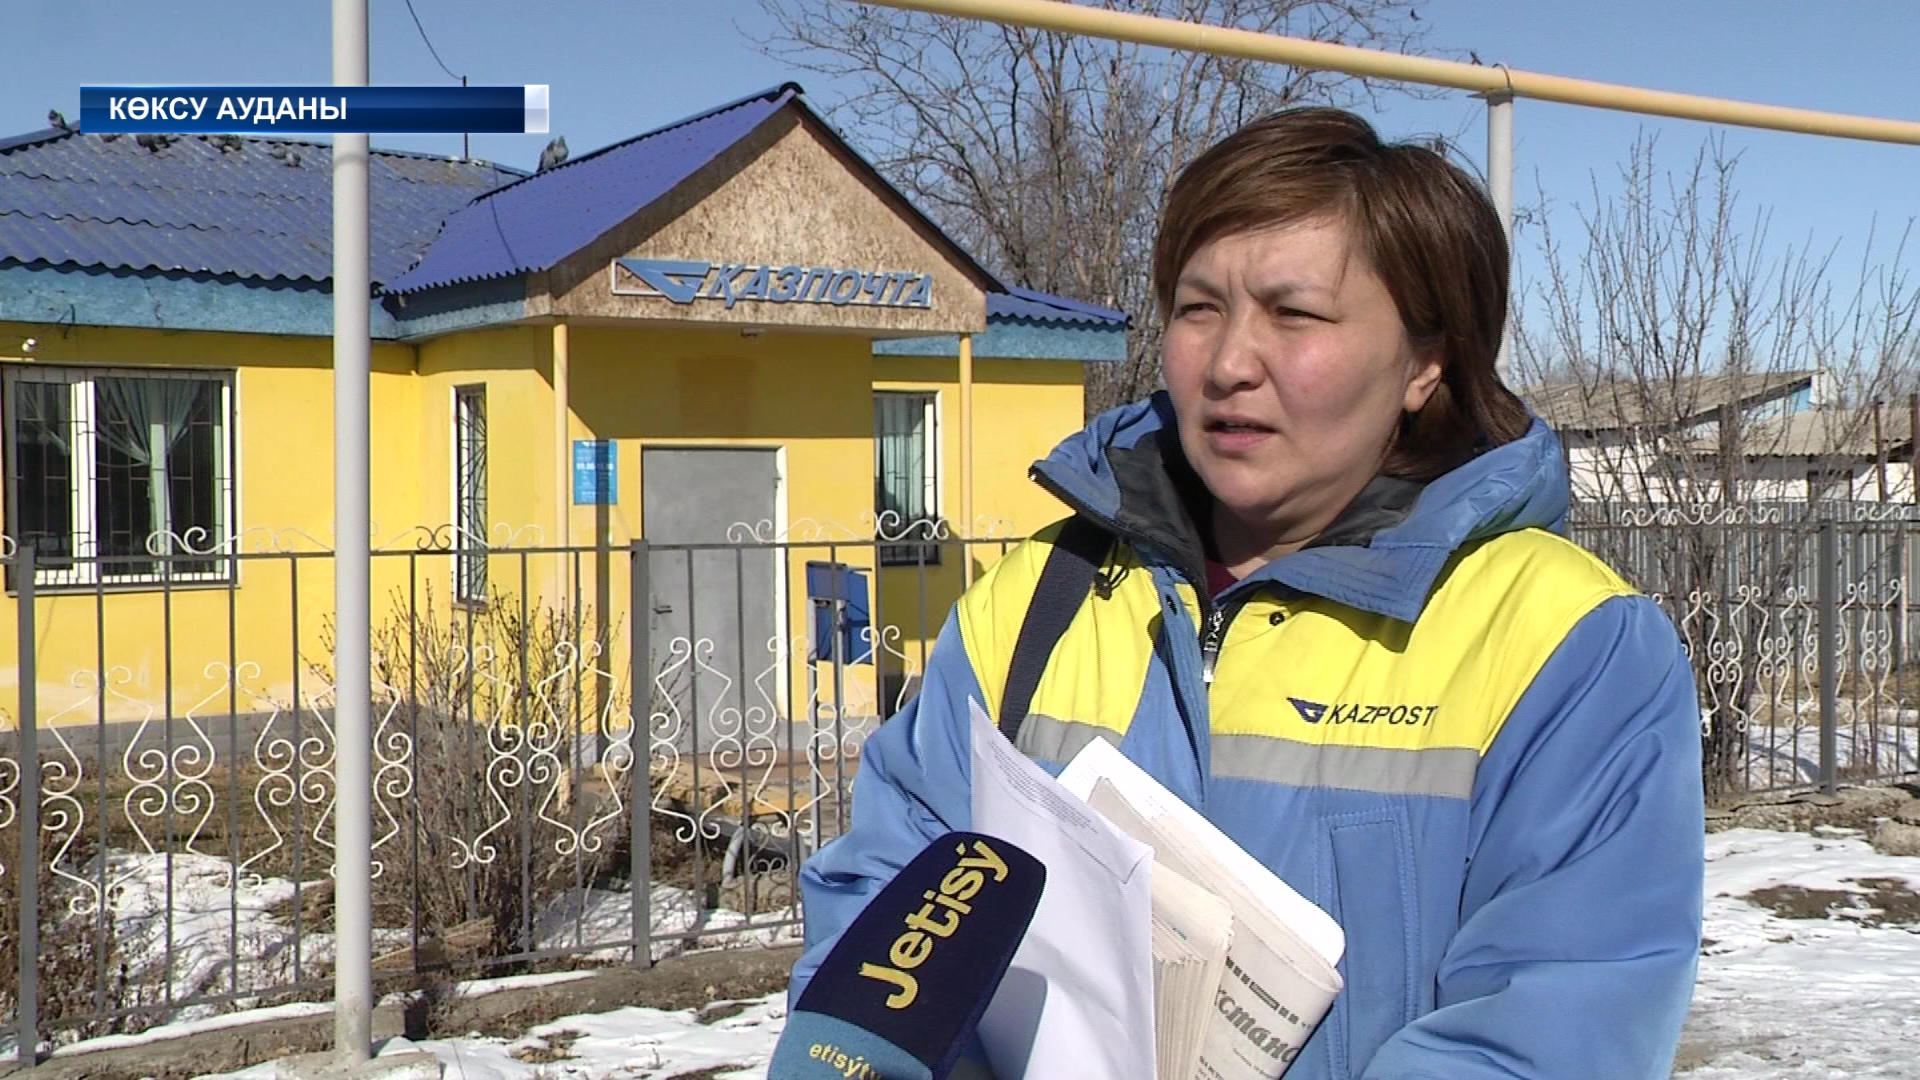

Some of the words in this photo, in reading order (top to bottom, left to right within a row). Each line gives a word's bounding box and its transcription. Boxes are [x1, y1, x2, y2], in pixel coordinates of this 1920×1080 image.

[707, 263, 934, 309] ҚАЗПОЧТА
[1324, 703, 1439, 727] KAZPOST
[858, 839, 1010, 1009] Jetisý
